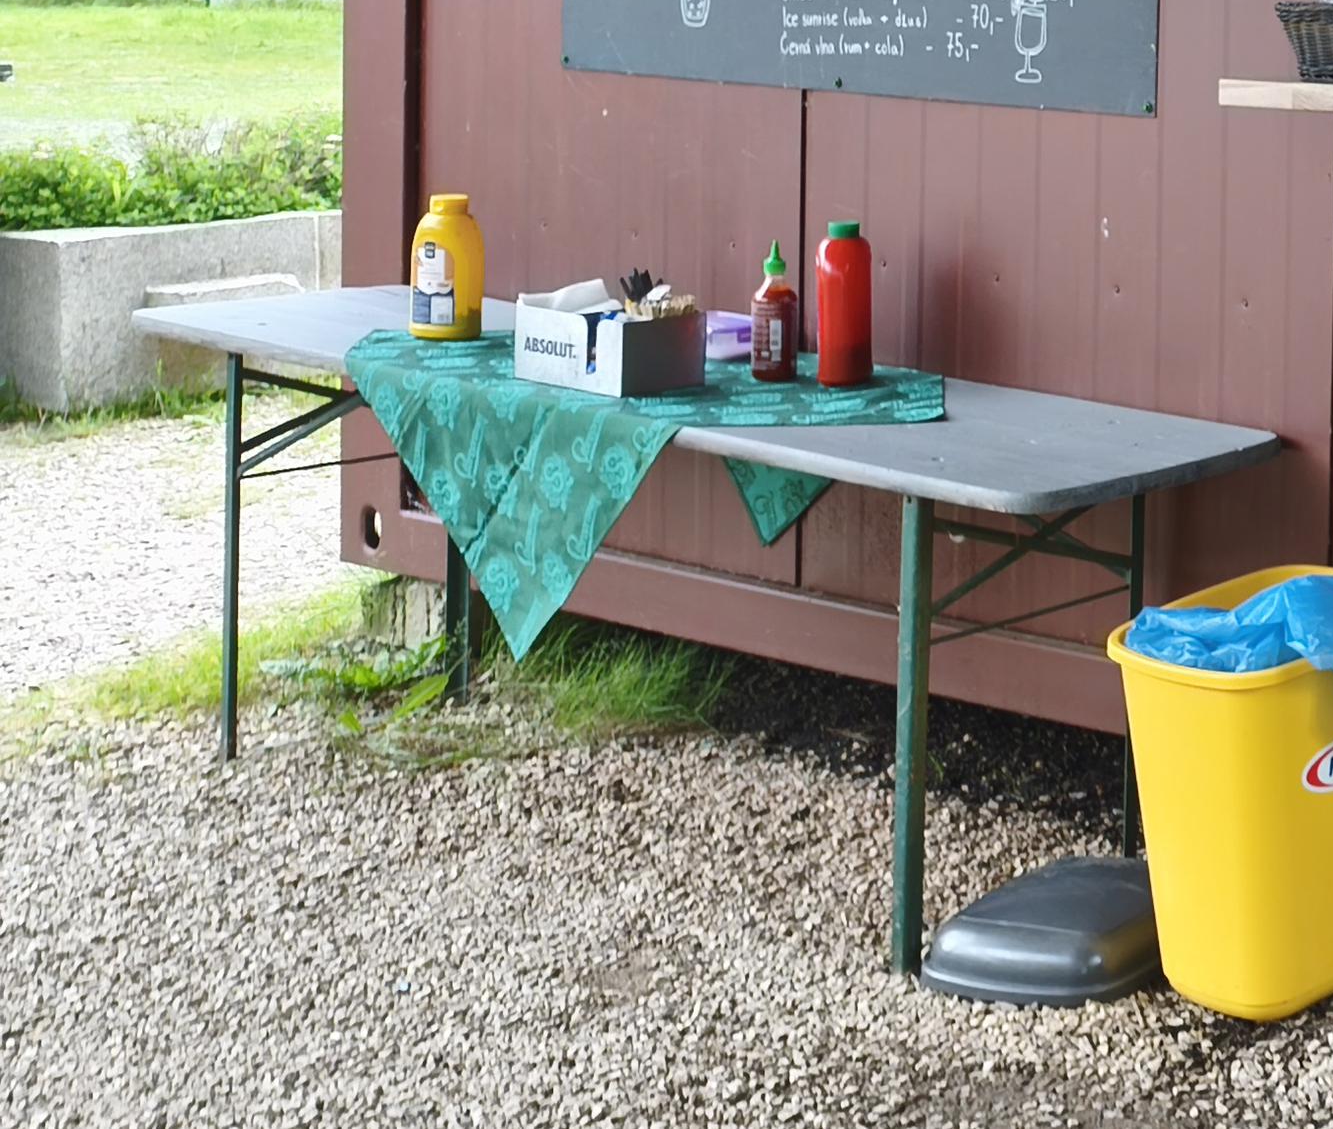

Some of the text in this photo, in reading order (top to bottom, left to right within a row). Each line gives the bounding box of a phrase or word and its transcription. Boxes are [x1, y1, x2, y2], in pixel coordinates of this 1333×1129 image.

[783, 7, 799, 27] Ice
[970, 3, 1004, 36] 70,-
[875, 33, 905, 57] cola)
[946, 31, 980, 62] 75,-
